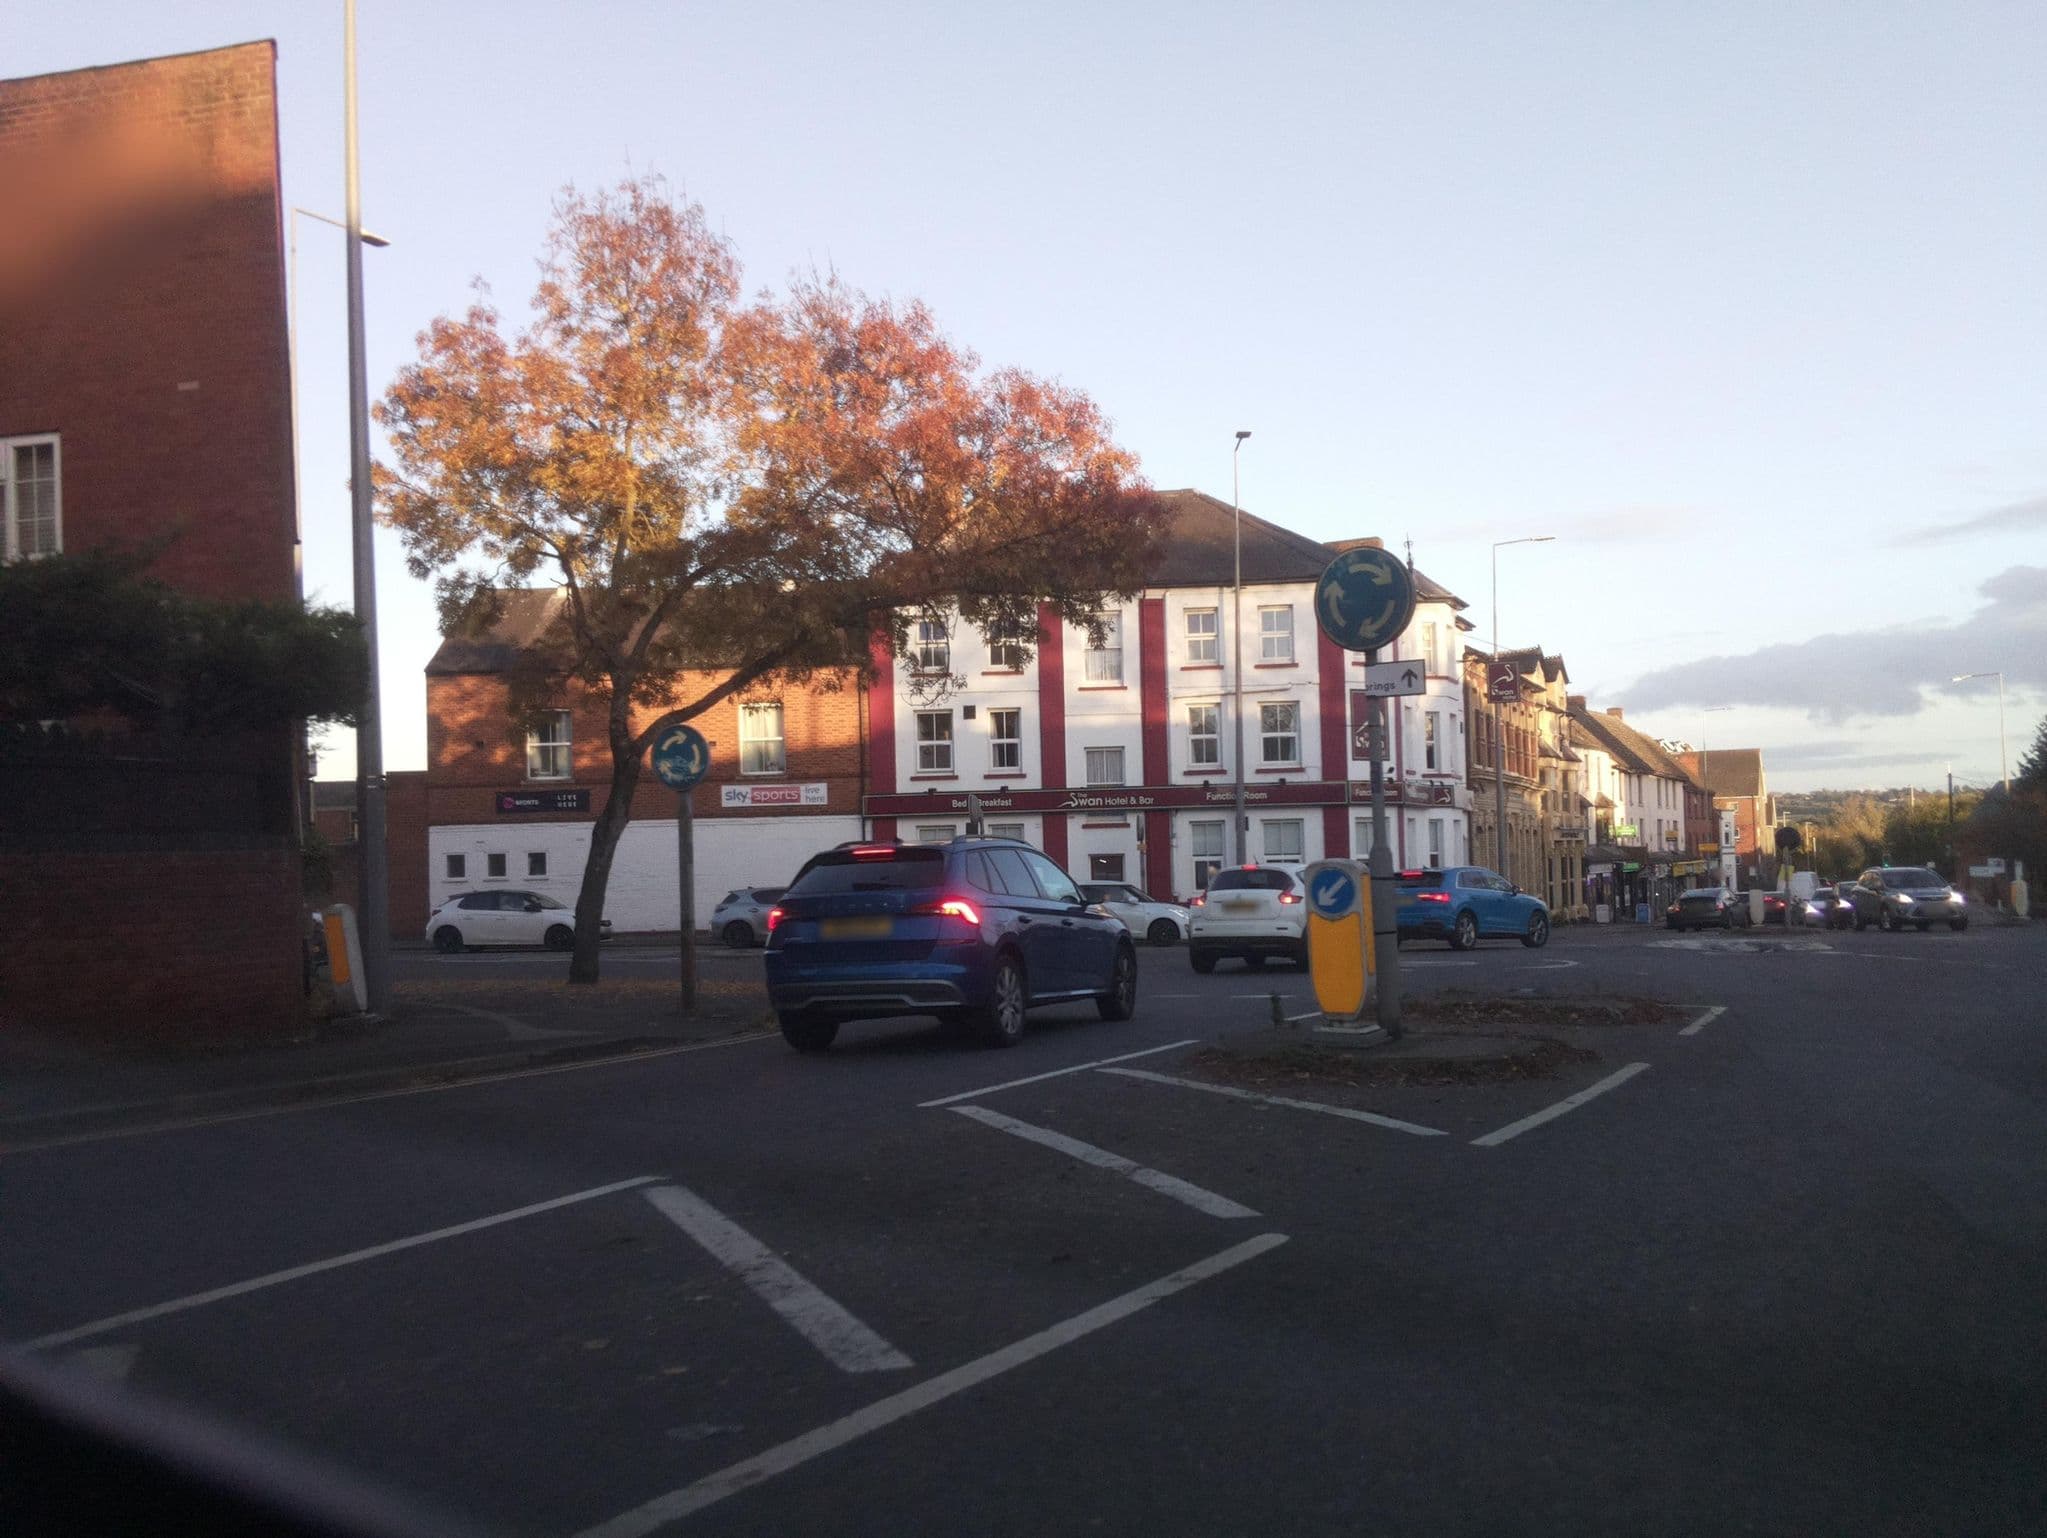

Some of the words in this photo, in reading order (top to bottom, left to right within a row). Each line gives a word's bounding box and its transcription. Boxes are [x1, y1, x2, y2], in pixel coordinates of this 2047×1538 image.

[805, 786, 820, 794] live
[725, 789, 749, 803] sky
[753, 790, 799, 803] sports
[1062, 793, 1103, 808] Swan
[1104, 796, 1129, 806] Hotel
[1129, 796, 1137, 805] &
[1138, 796, 1154, 805] Bar
[952, 799, 968, 808] Bed
